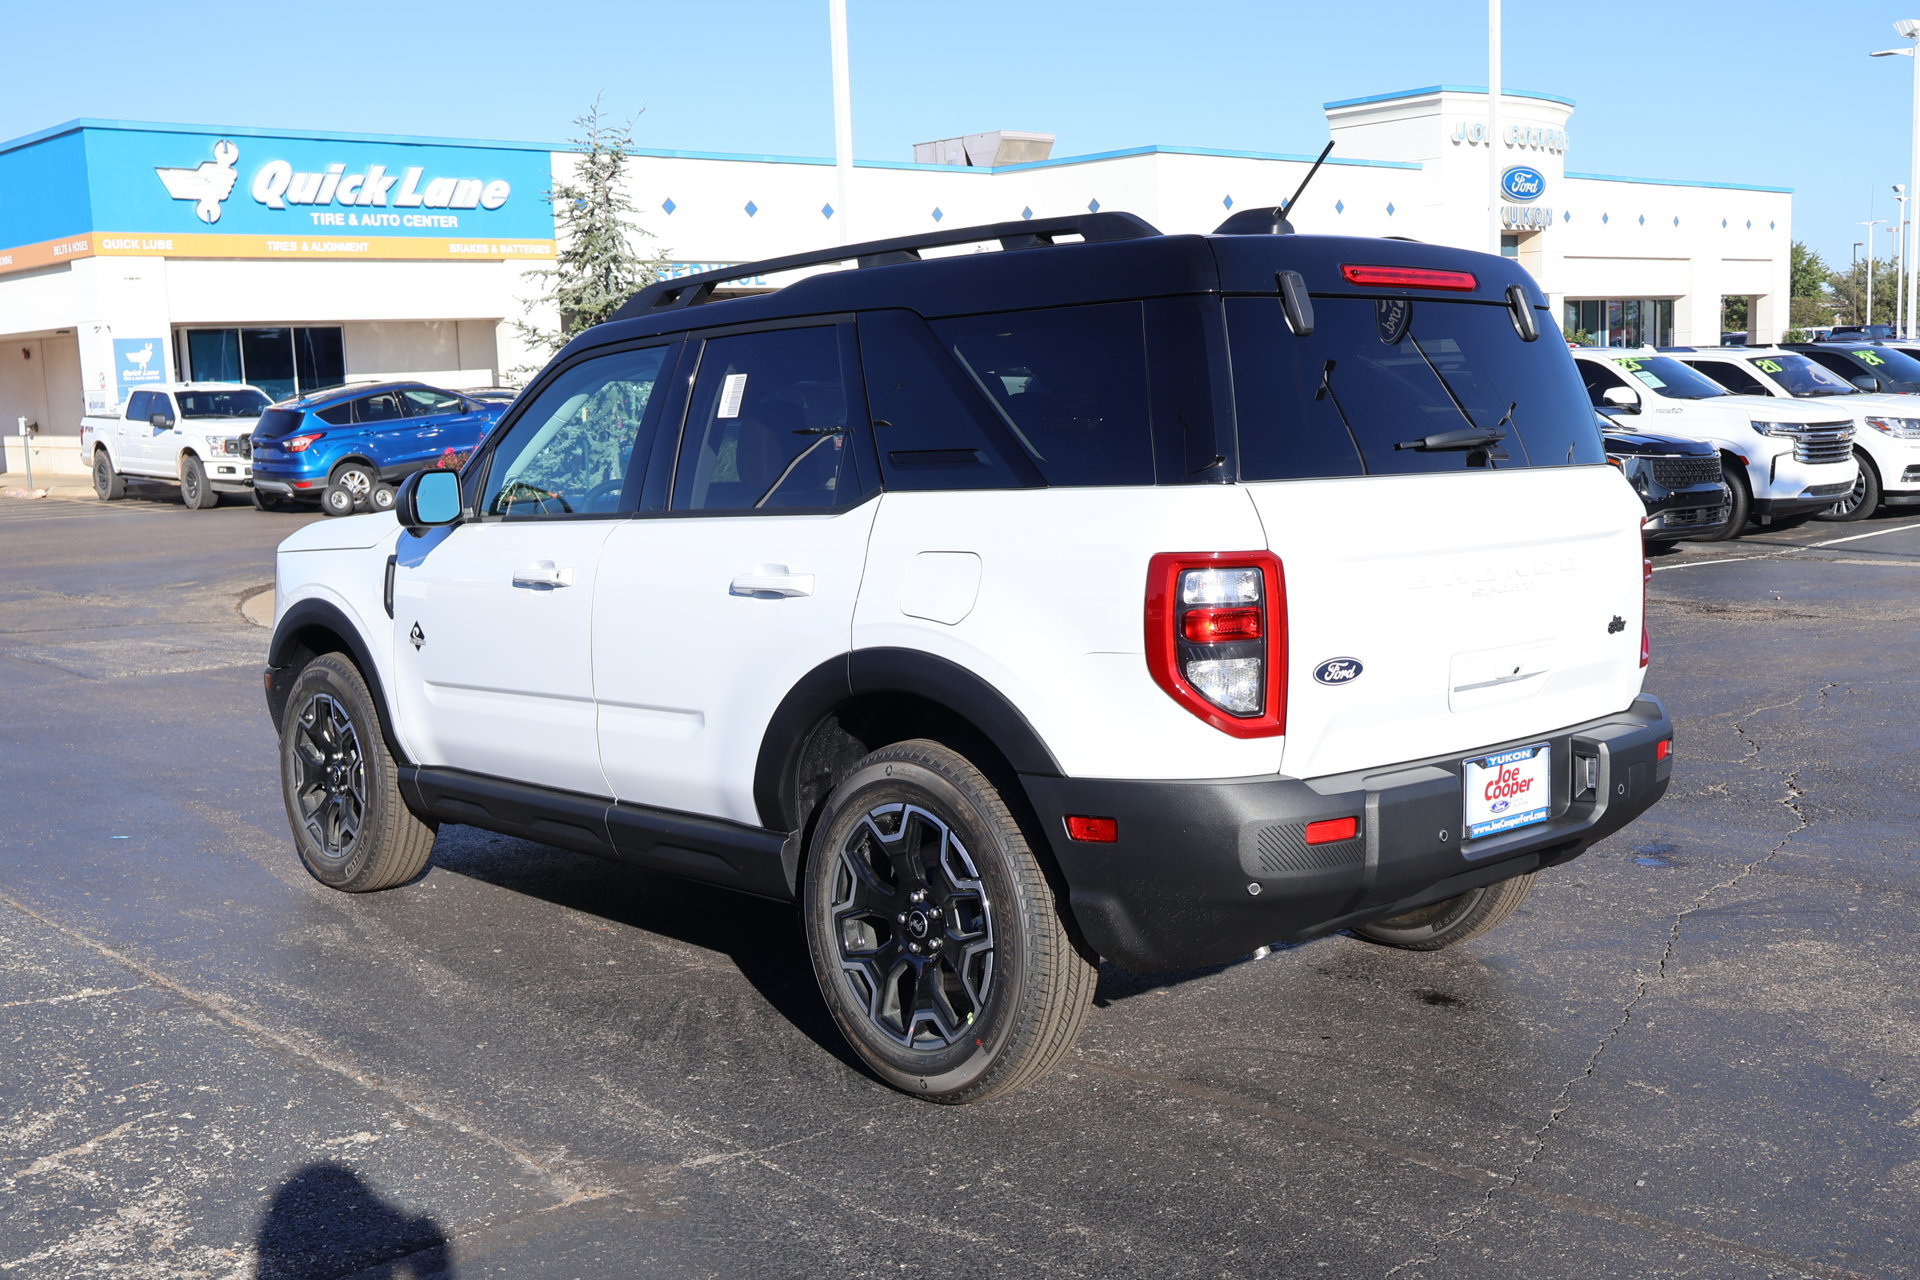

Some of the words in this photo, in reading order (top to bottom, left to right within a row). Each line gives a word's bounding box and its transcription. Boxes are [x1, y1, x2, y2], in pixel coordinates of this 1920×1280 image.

[251, 159, 398, 210] Quick
[393, 167, 511, 210] Lane
[310, 212, 346, 226] TIRE
[349, 213, 359, 226] &
[361, 213, 400, 227] AUTO
[403, 215, 458, 228] CENTER
[102, 238, 140, 250] QUICK
[142, 239, 173, 250] LUBE
[266, 241, 297, 252] TIRES
[302, 242, 309, 252] &
[311, 241, 370, 253] ALIGNMENT
[449, 243, 489, 254] BRAKES
[491, 244, 498, 254] &
[500, 244, 551, 255] BATTERIES
[1755, 359, 1783, 374] 20
[1490, 750, 1532, 766] YUKON
[1495, 764, 1520, 786] Joe
[1484, 777, 1534, 801] Cooper
